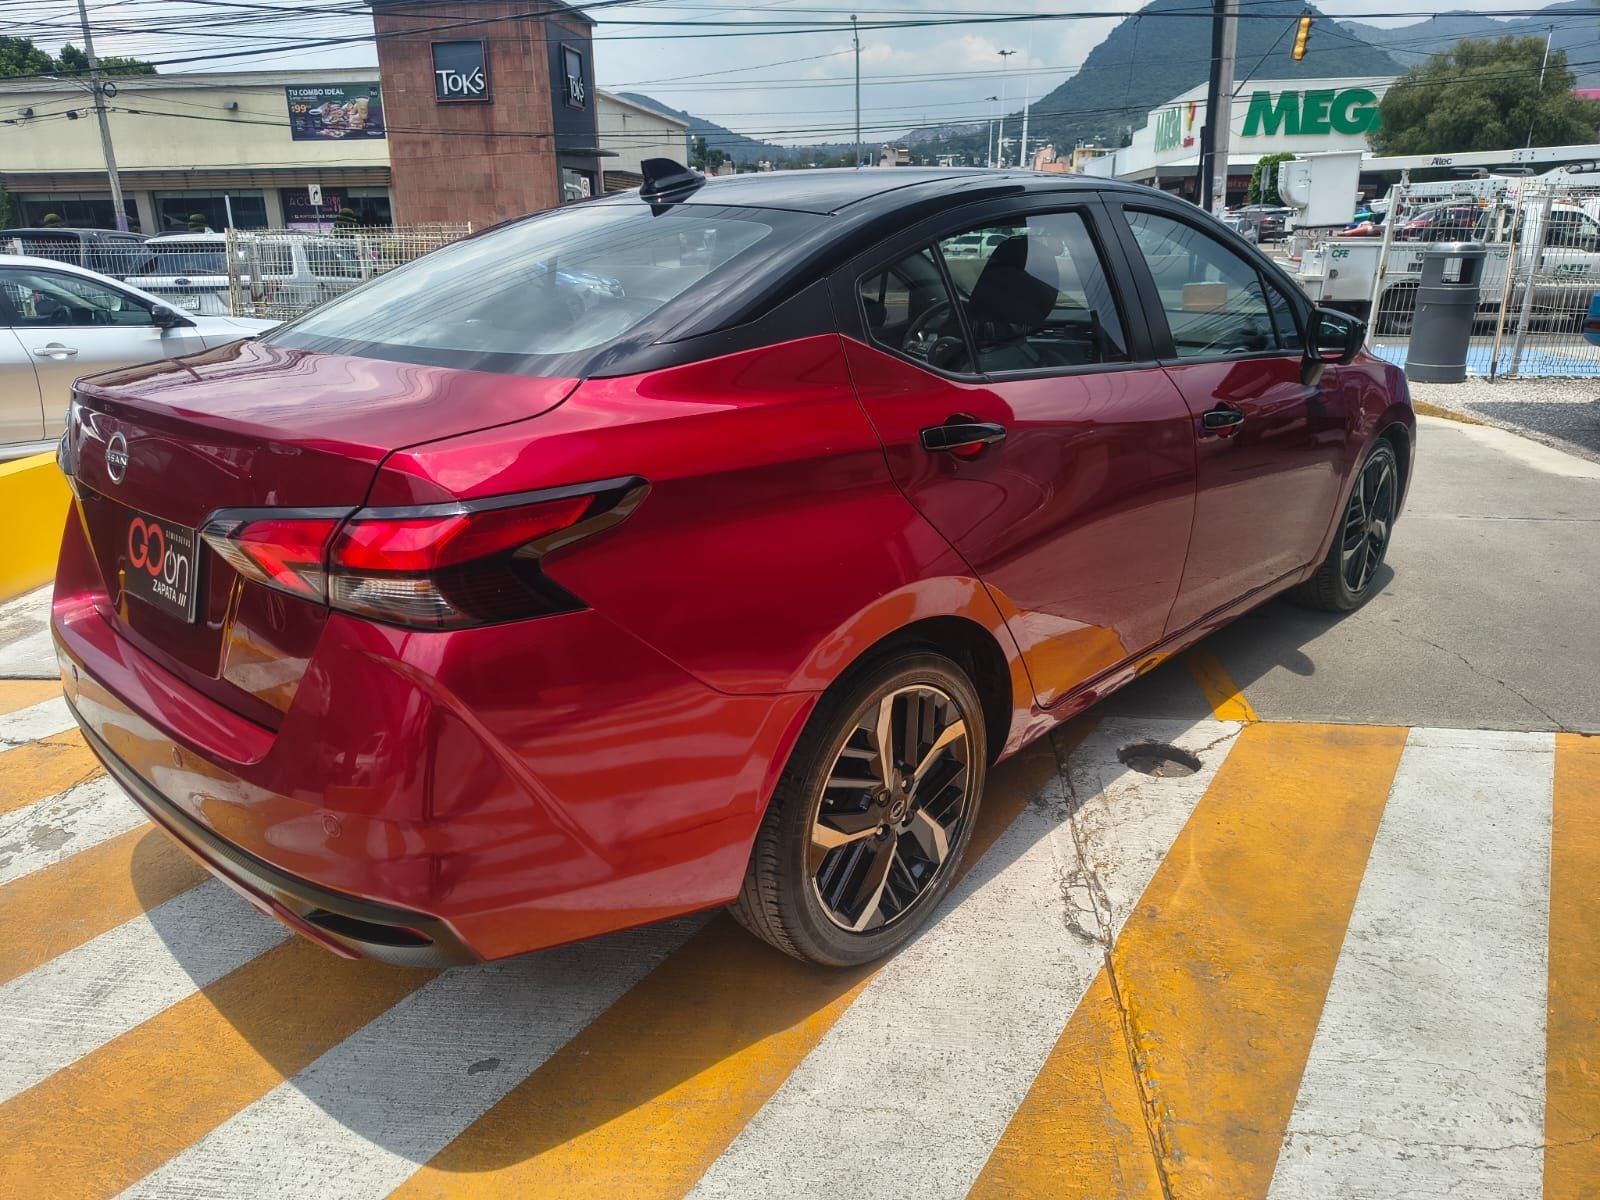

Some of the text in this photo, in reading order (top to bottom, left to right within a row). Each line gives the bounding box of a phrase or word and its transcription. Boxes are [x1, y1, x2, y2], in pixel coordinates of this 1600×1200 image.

[299, 88, 324, 96] COMBO
[1430, 156, 1452, 165] Altec
[1331, 249, 1350, 258] CFE
[153, 578, 177, 602] ZAPATA
